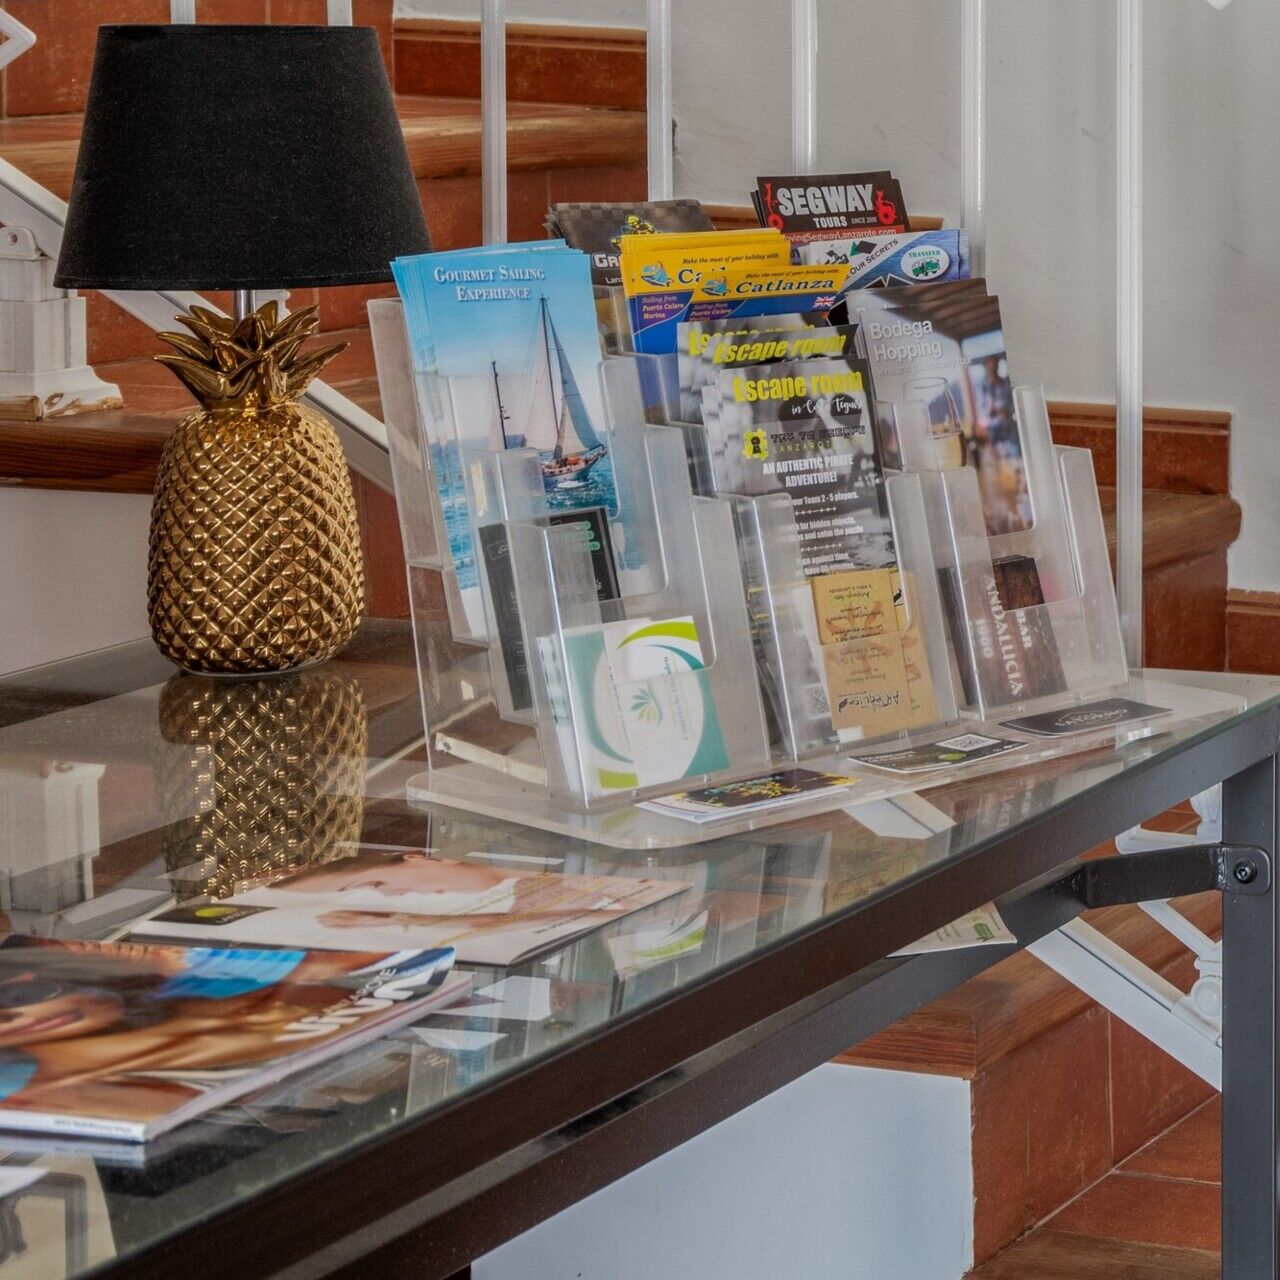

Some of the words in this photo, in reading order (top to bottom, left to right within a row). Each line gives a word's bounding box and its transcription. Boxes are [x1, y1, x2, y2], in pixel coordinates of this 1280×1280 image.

[777, 184, 875, 216] SEGWAY
[813, 216, 848, 229] TOURS
[850, 261, 866, 275] OUR
[865, 239, 899, 264] SECRETS
[909, 250, 941, 258] TRANSFER
[434, 266, 495, 283] GOURMET
[499, 265, 545, 281] SAILING
[455, 285, 531, 302] EXPERIENCE
[736, 280, 834, 294] Catlanza
[662, 295, 677, 304] from
[870, 320, 933, 339] Bodega
[713, 339, 789, 365] Escape
[791, 335, 847, 358] room
[874, 340, 943, 362] Hopping
[733, 374, 808, 403] Escape
[811, 371, 864, 396] room
[792, 405, 802, 415] in
[763, 462, 775, 475] AN
[776, 456, 824, 473] AUTHENTIC
[825, 454, 854, 469] PIRATE
[786, 471, 838, 488] ADVENTURE!
[804, 496, 820, 504] Team
[821, 494, 826, 502] 2
[830, 494, 834, 502] 5
[985, 575, 1024, 697] ANDALUCIA
[1015, 610, 1032, 649] BAR
